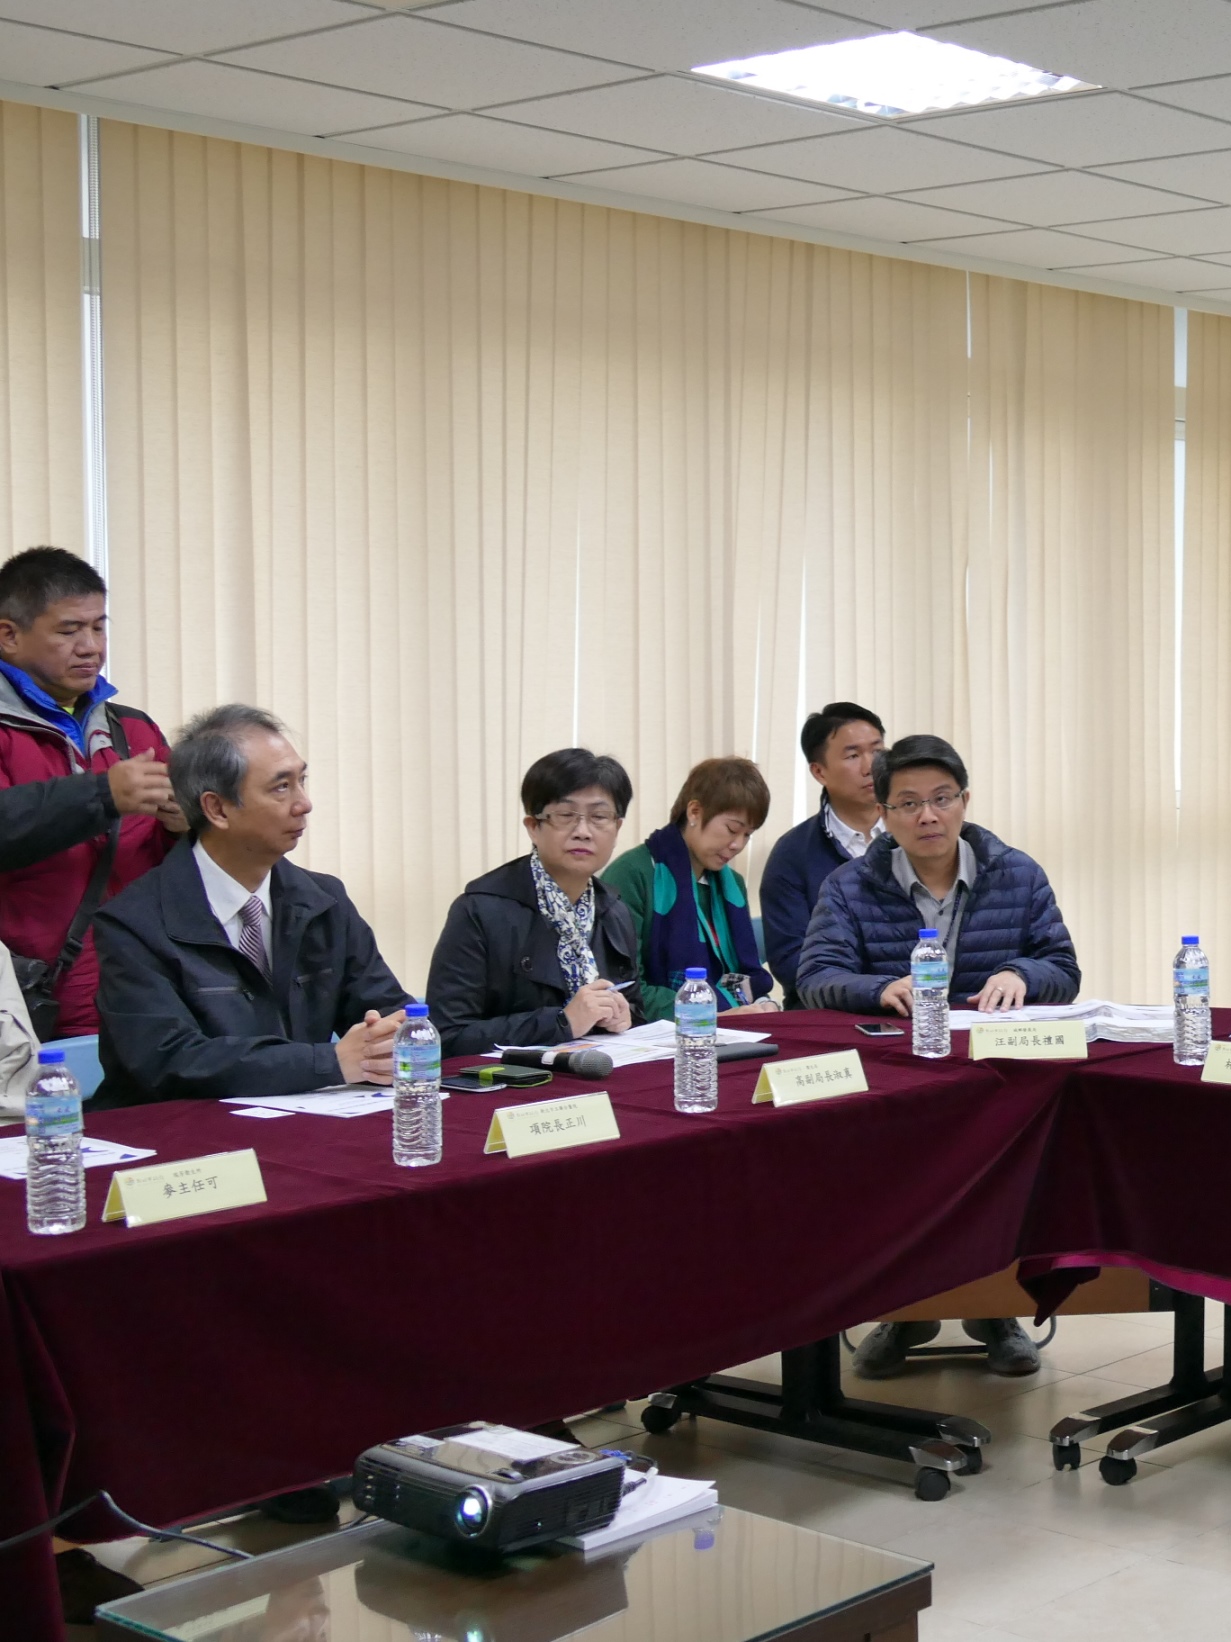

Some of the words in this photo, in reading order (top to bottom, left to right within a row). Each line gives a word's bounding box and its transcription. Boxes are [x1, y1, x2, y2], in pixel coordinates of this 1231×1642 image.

[995, 1034, 1065, 1047] 汪副局長禮國
[529, 1114, 587, 1136] 項院長正川
